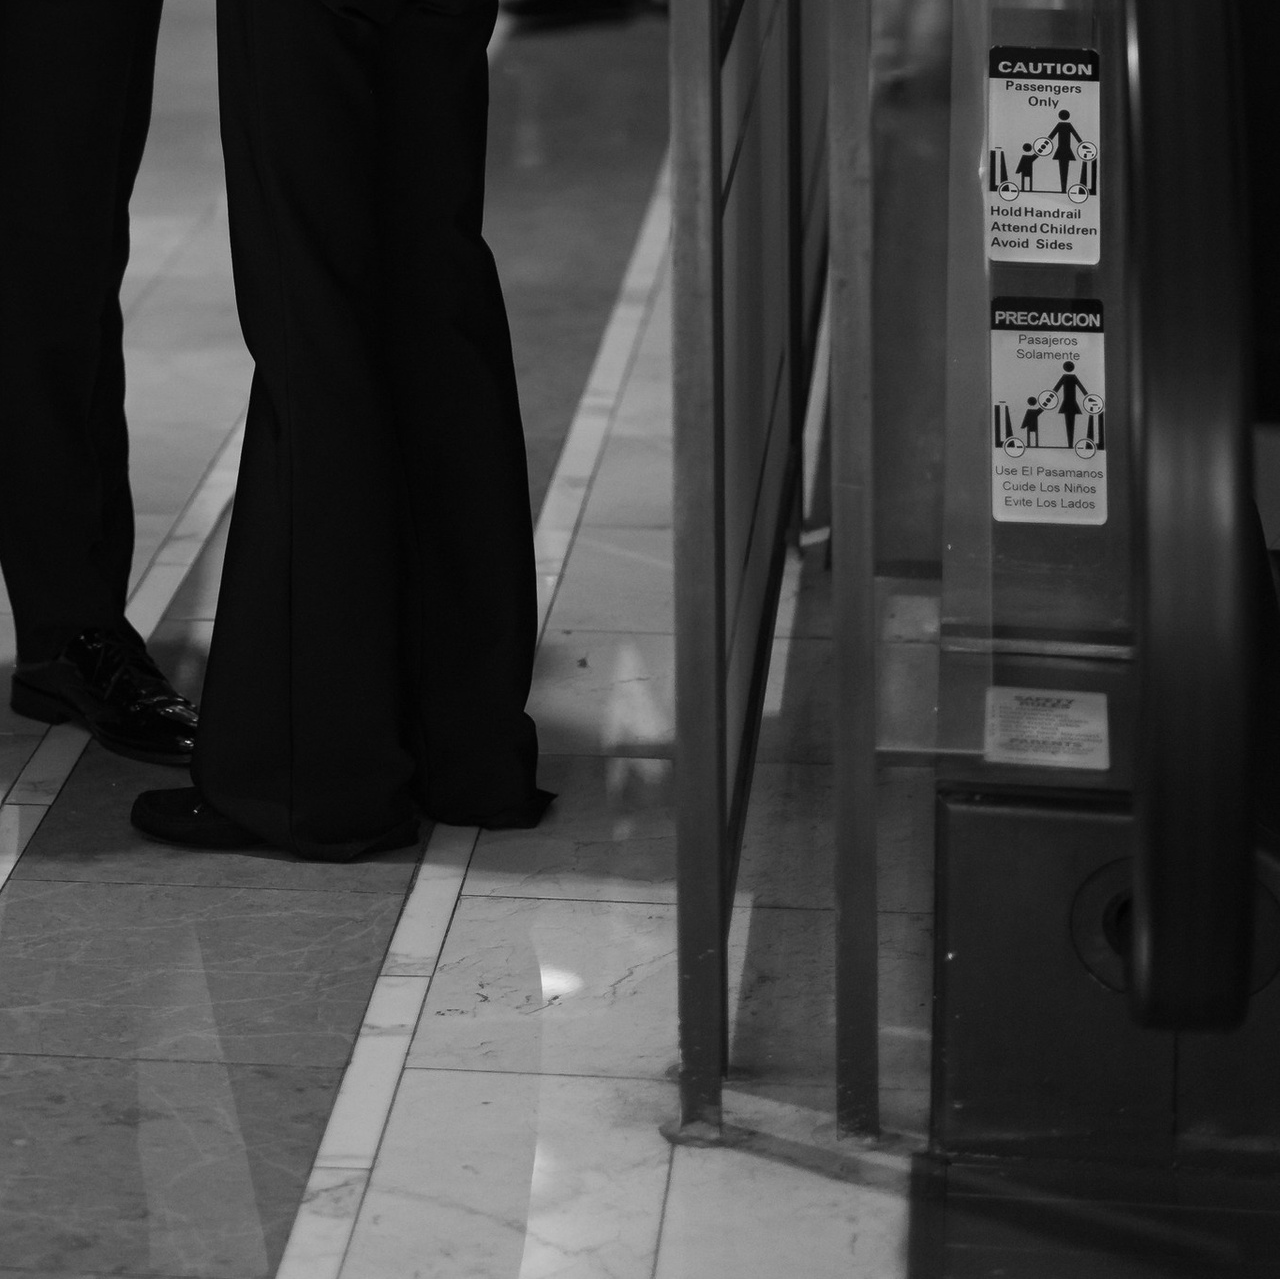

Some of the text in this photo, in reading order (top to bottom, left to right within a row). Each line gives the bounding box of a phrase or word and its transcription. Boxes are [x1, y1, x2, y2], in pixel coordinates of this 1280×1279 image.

[998, 61, 1093, 76] CAUTION
[1005, 80, 1082, 95] Passengers
[1028, 96, 1059, 109] Only
[990, 206, 1081, 219] Hold Handrail
[991, 221, 1097, 236] Attend Children
[991, 237, 1073, 250] Avoid Sides
[994, 310, 1101, 327] PRECAUCION
[1018, 334, 1078, 348] Pasajeros
[1016, 349, 1080, 361] Solamente
[995, 465, 1104, 479] Use El Pasamanos
[1002, 481, 1097, 494] Cuide Los Niños
[1005, 497, 1096, 509] Evite Los Lados
